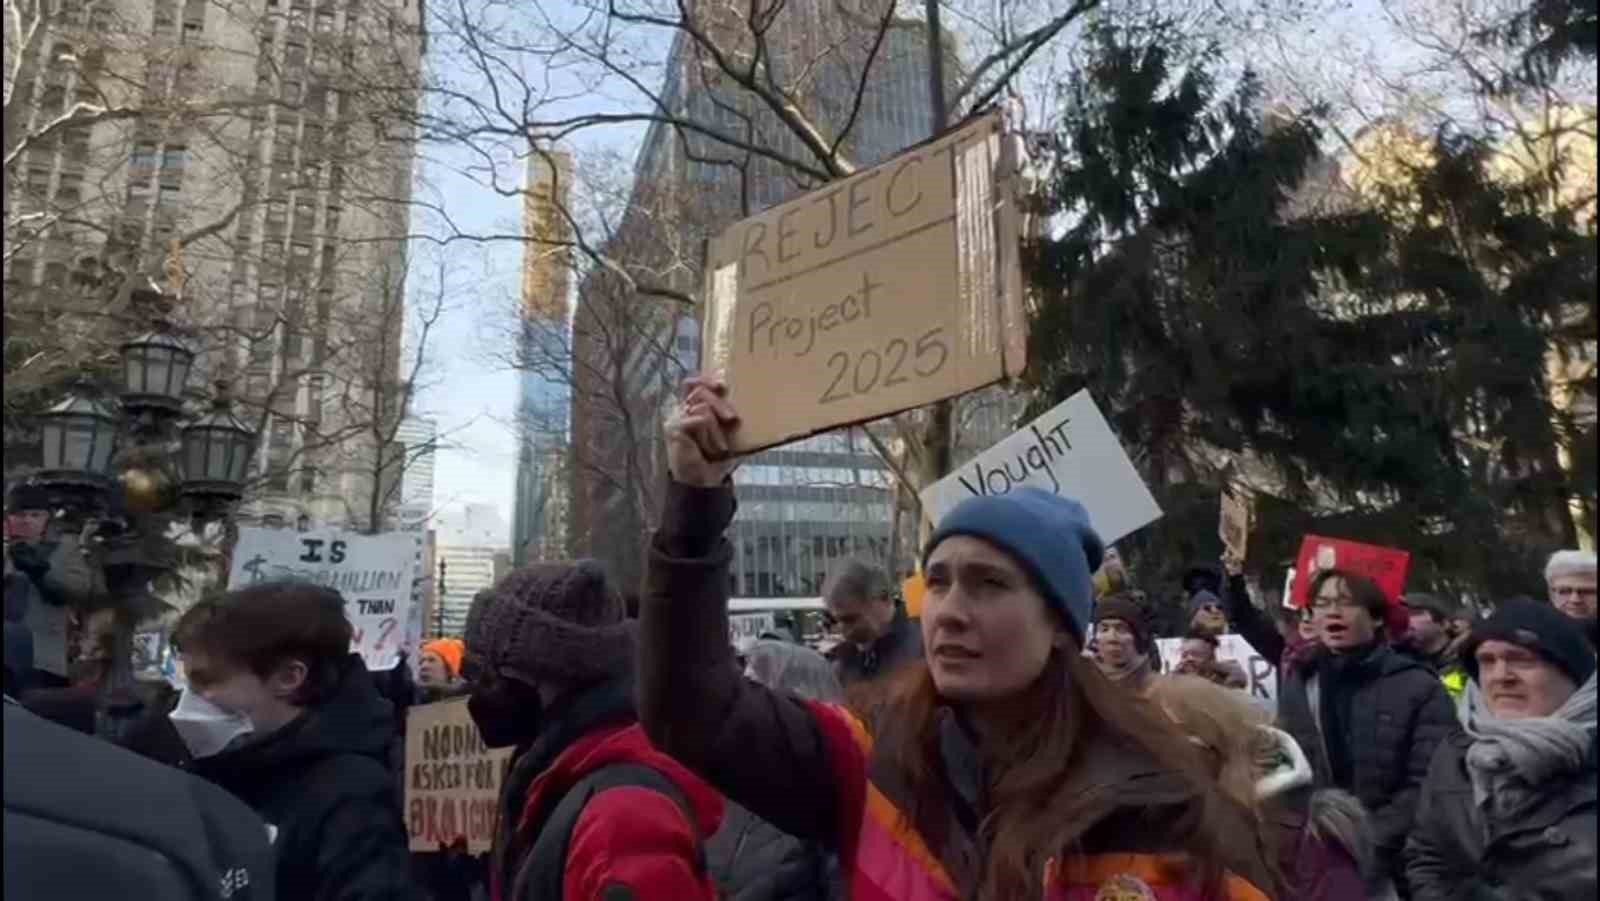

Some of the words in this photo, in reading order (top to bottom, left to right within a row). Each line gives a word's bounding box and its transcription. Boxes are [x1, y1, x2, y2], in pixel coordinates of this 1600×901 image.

[748, 271, 885, 358] Project
[818, 326, 948, 405] 2025
[958, 418, 1073, 496] Vought
[299, 538, 348, 564] IS
[357, 598, 396, 615] THAN
